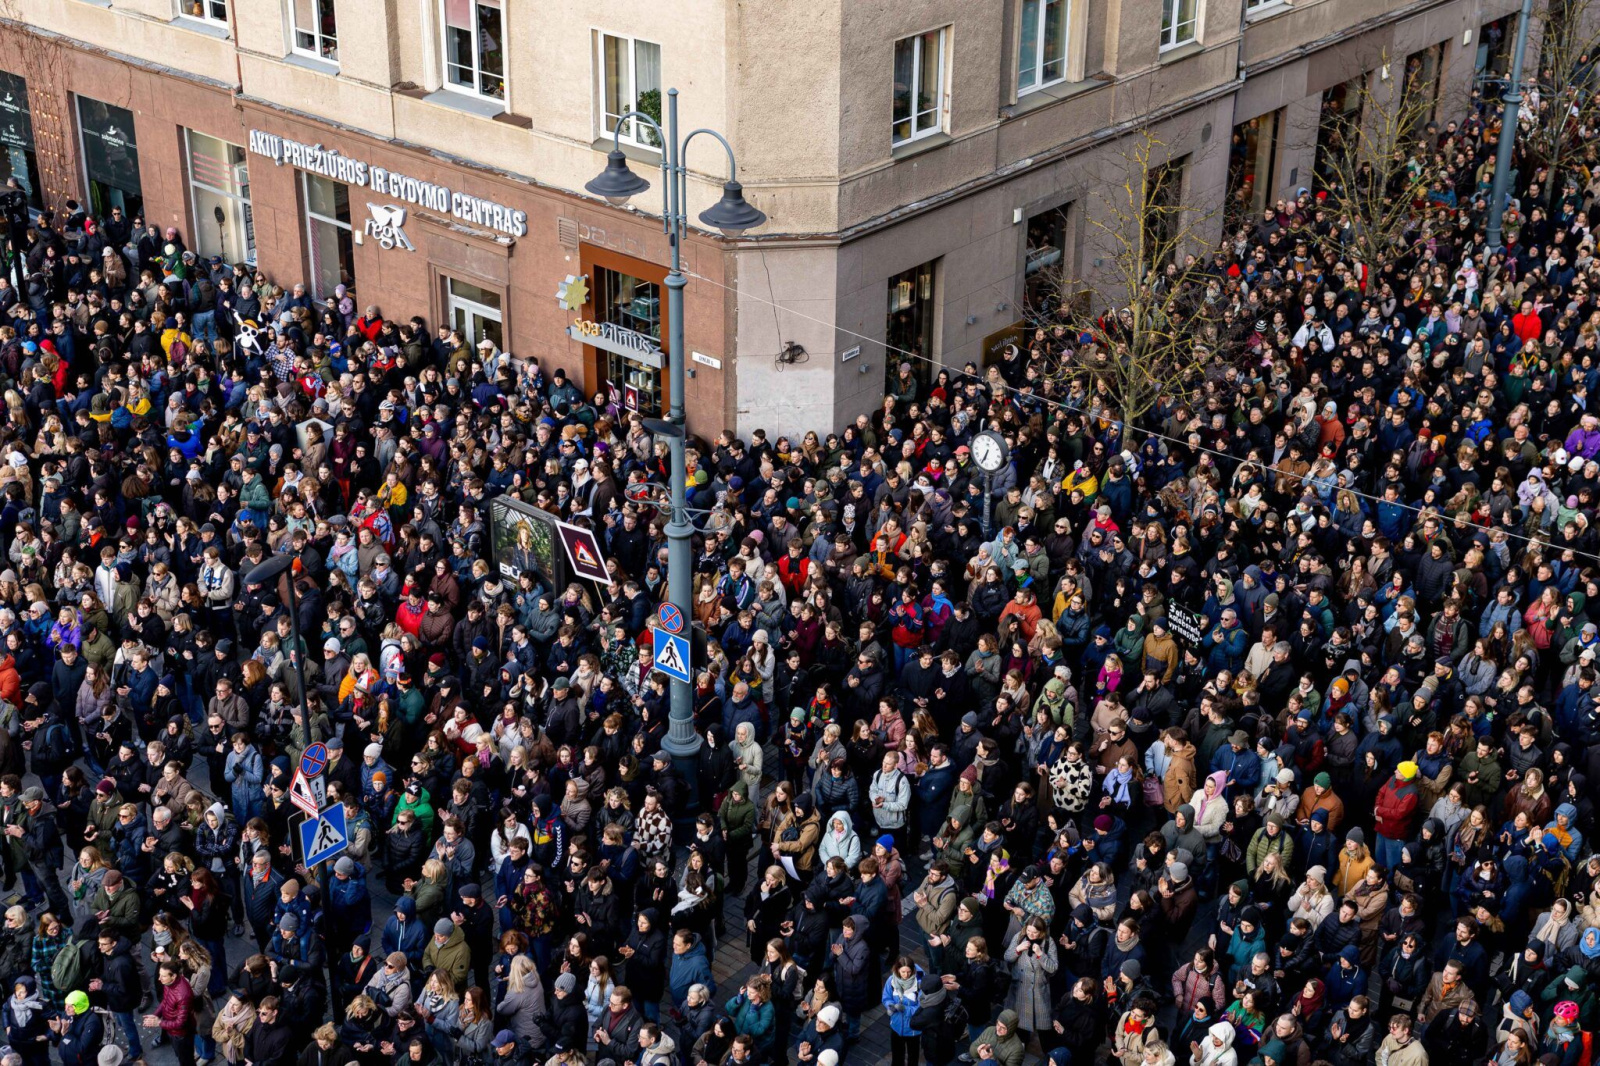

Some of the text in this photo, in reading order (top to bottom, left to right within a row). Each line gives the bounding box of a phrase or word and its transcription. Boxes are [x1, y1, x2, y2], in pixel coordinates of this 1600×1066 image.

[249, 129, 527, 237] AKIŲ PRIEŽIŪROS IR GYDYMO CENTRAS
[499, 562, 521, 580] BŪ
